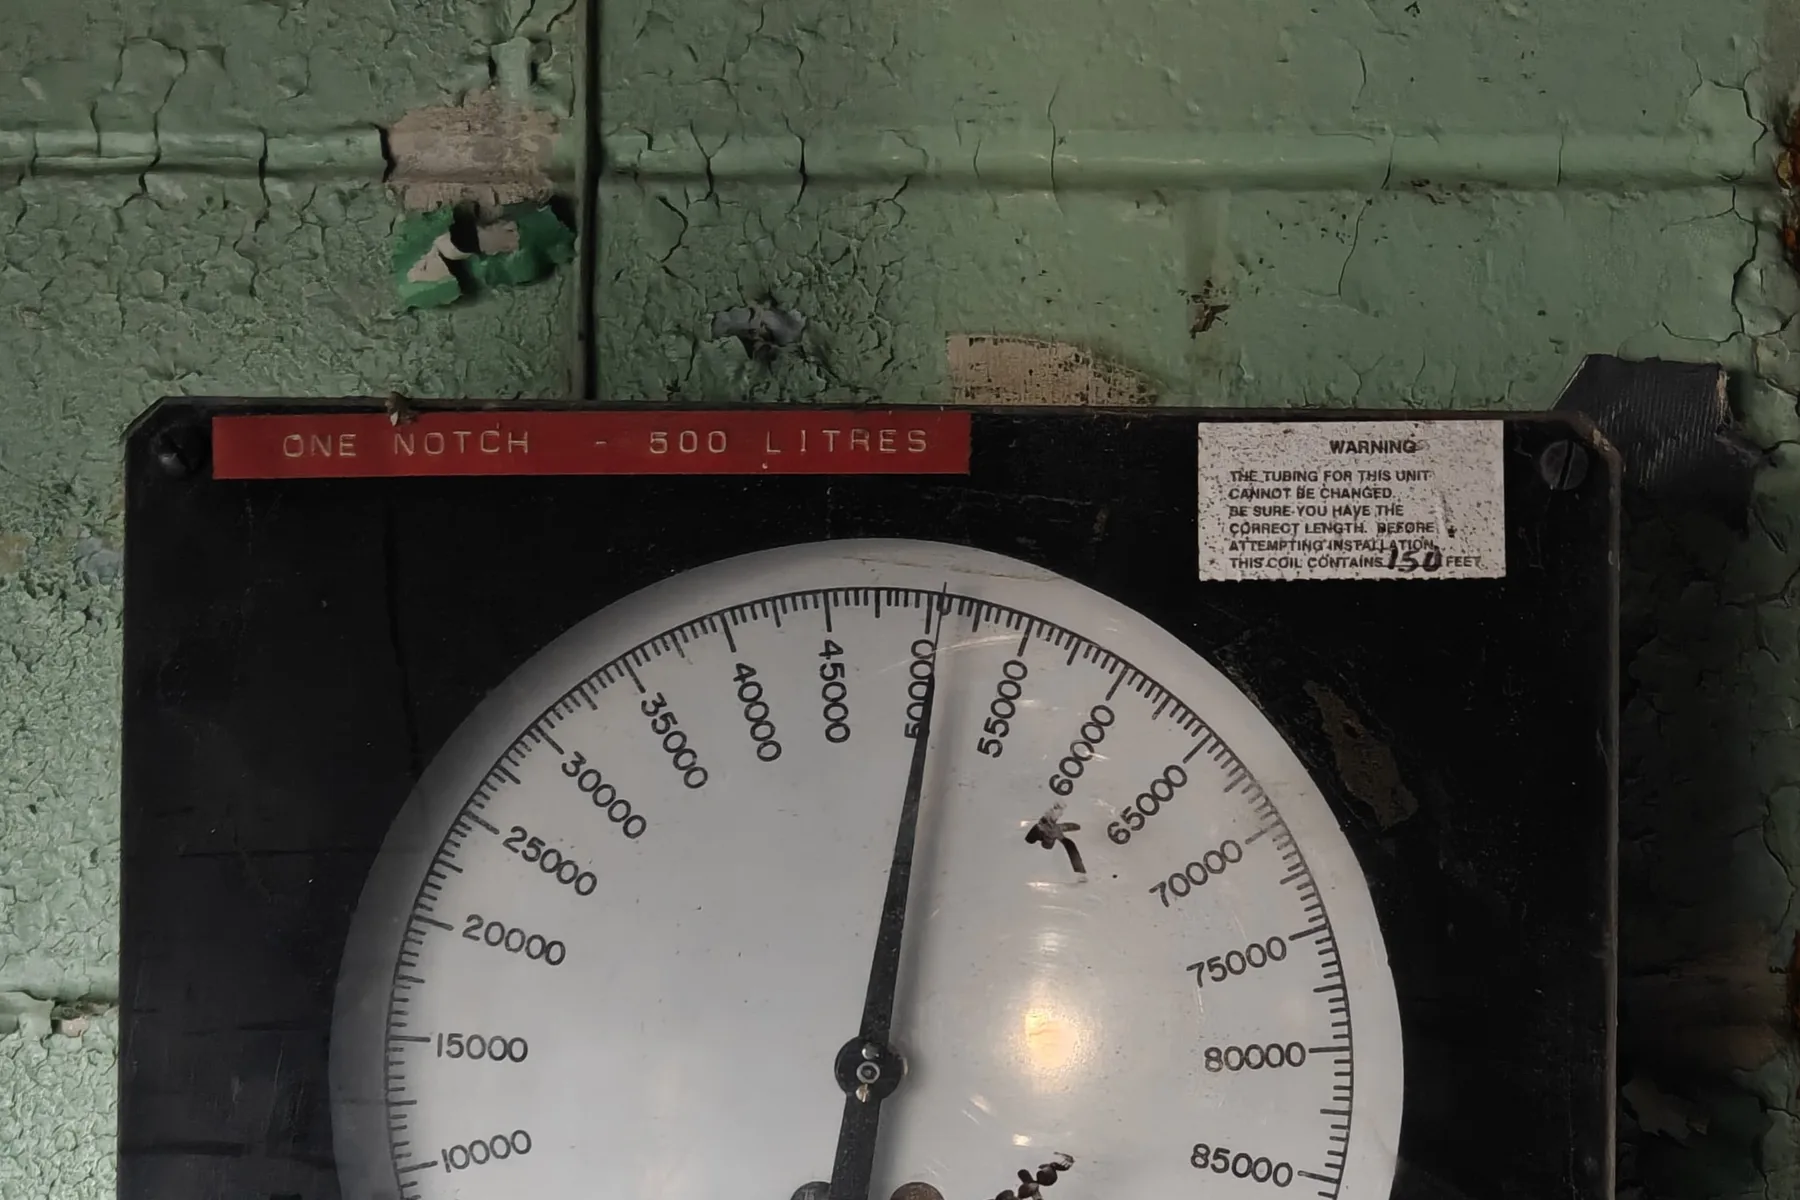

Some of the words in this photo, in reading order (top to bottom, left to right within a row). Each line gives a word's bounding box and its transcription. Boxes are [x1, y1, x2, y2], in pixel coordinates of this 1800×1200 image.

[283, 434, 356, 457] ONE
[395, 432, 529, 455] NOTCH
[648, 430, 728, 455] 500
[765, 429, 929, 453] LITRES
[1329, 439, 1417, 454] WARNING
[1229, 488, 1291, 500] CANNOT
[1297, 487, 1315, 499] BE
[1230, 470, 1257, 482] THE
[1263, 470, 1318, 482] TUBING
[1323, 470, 1352, 482] FOR
[1357, 470, 1391, 482] THIS
[1395, 470, 1429, 482] UNIT
[1229, 505, 1248, 518] BE
[1253, 505, 1290, 517] SURE
[1297, 505, 1328, 517] YOU
[1332, 505, 1371, 518] HAVE
[1376, 505, 1404, 517] THE
[1229, 523, 1300, 535] CORRECT
[1377, 522, 1435, 534] BEFORE
[1229, 540, 1323, 552] ATTEMPTING
[1230, 558, 1263, 569] THIS
[1268, 557, 1301, 569] COIL
[1307, 557, 1383, 569] CONTAINS
[1387, 546, 1443, 573] 150
[1446, 556, 1481, 570] FEET
[733, 662, 782, 762] 40000
[818, 639, 850, 743] 45000
[904, 639, 935, 739] 50000
[977, 659, 1028, 758] 55000
[640, 692, 708, 789] 35000
[1049, 704, 1115, 797] 60000
[561, 751, 647, 839] 30000
[1106, 764, 1188, 845] 65000
[502, 825, 597, 896] 25000
[1149, 839, 1243, 908] 70000
[462, 914, 566, 966] 20000
[1186, 936, 1287, 988] 75000
[436, 1032, 528, 1063] 15000
[1204, 1041, 1306, 1073] 80000
[441, 1129, 532, 1173] 10000
[1191, 1143, 1292, 1187] 85000
